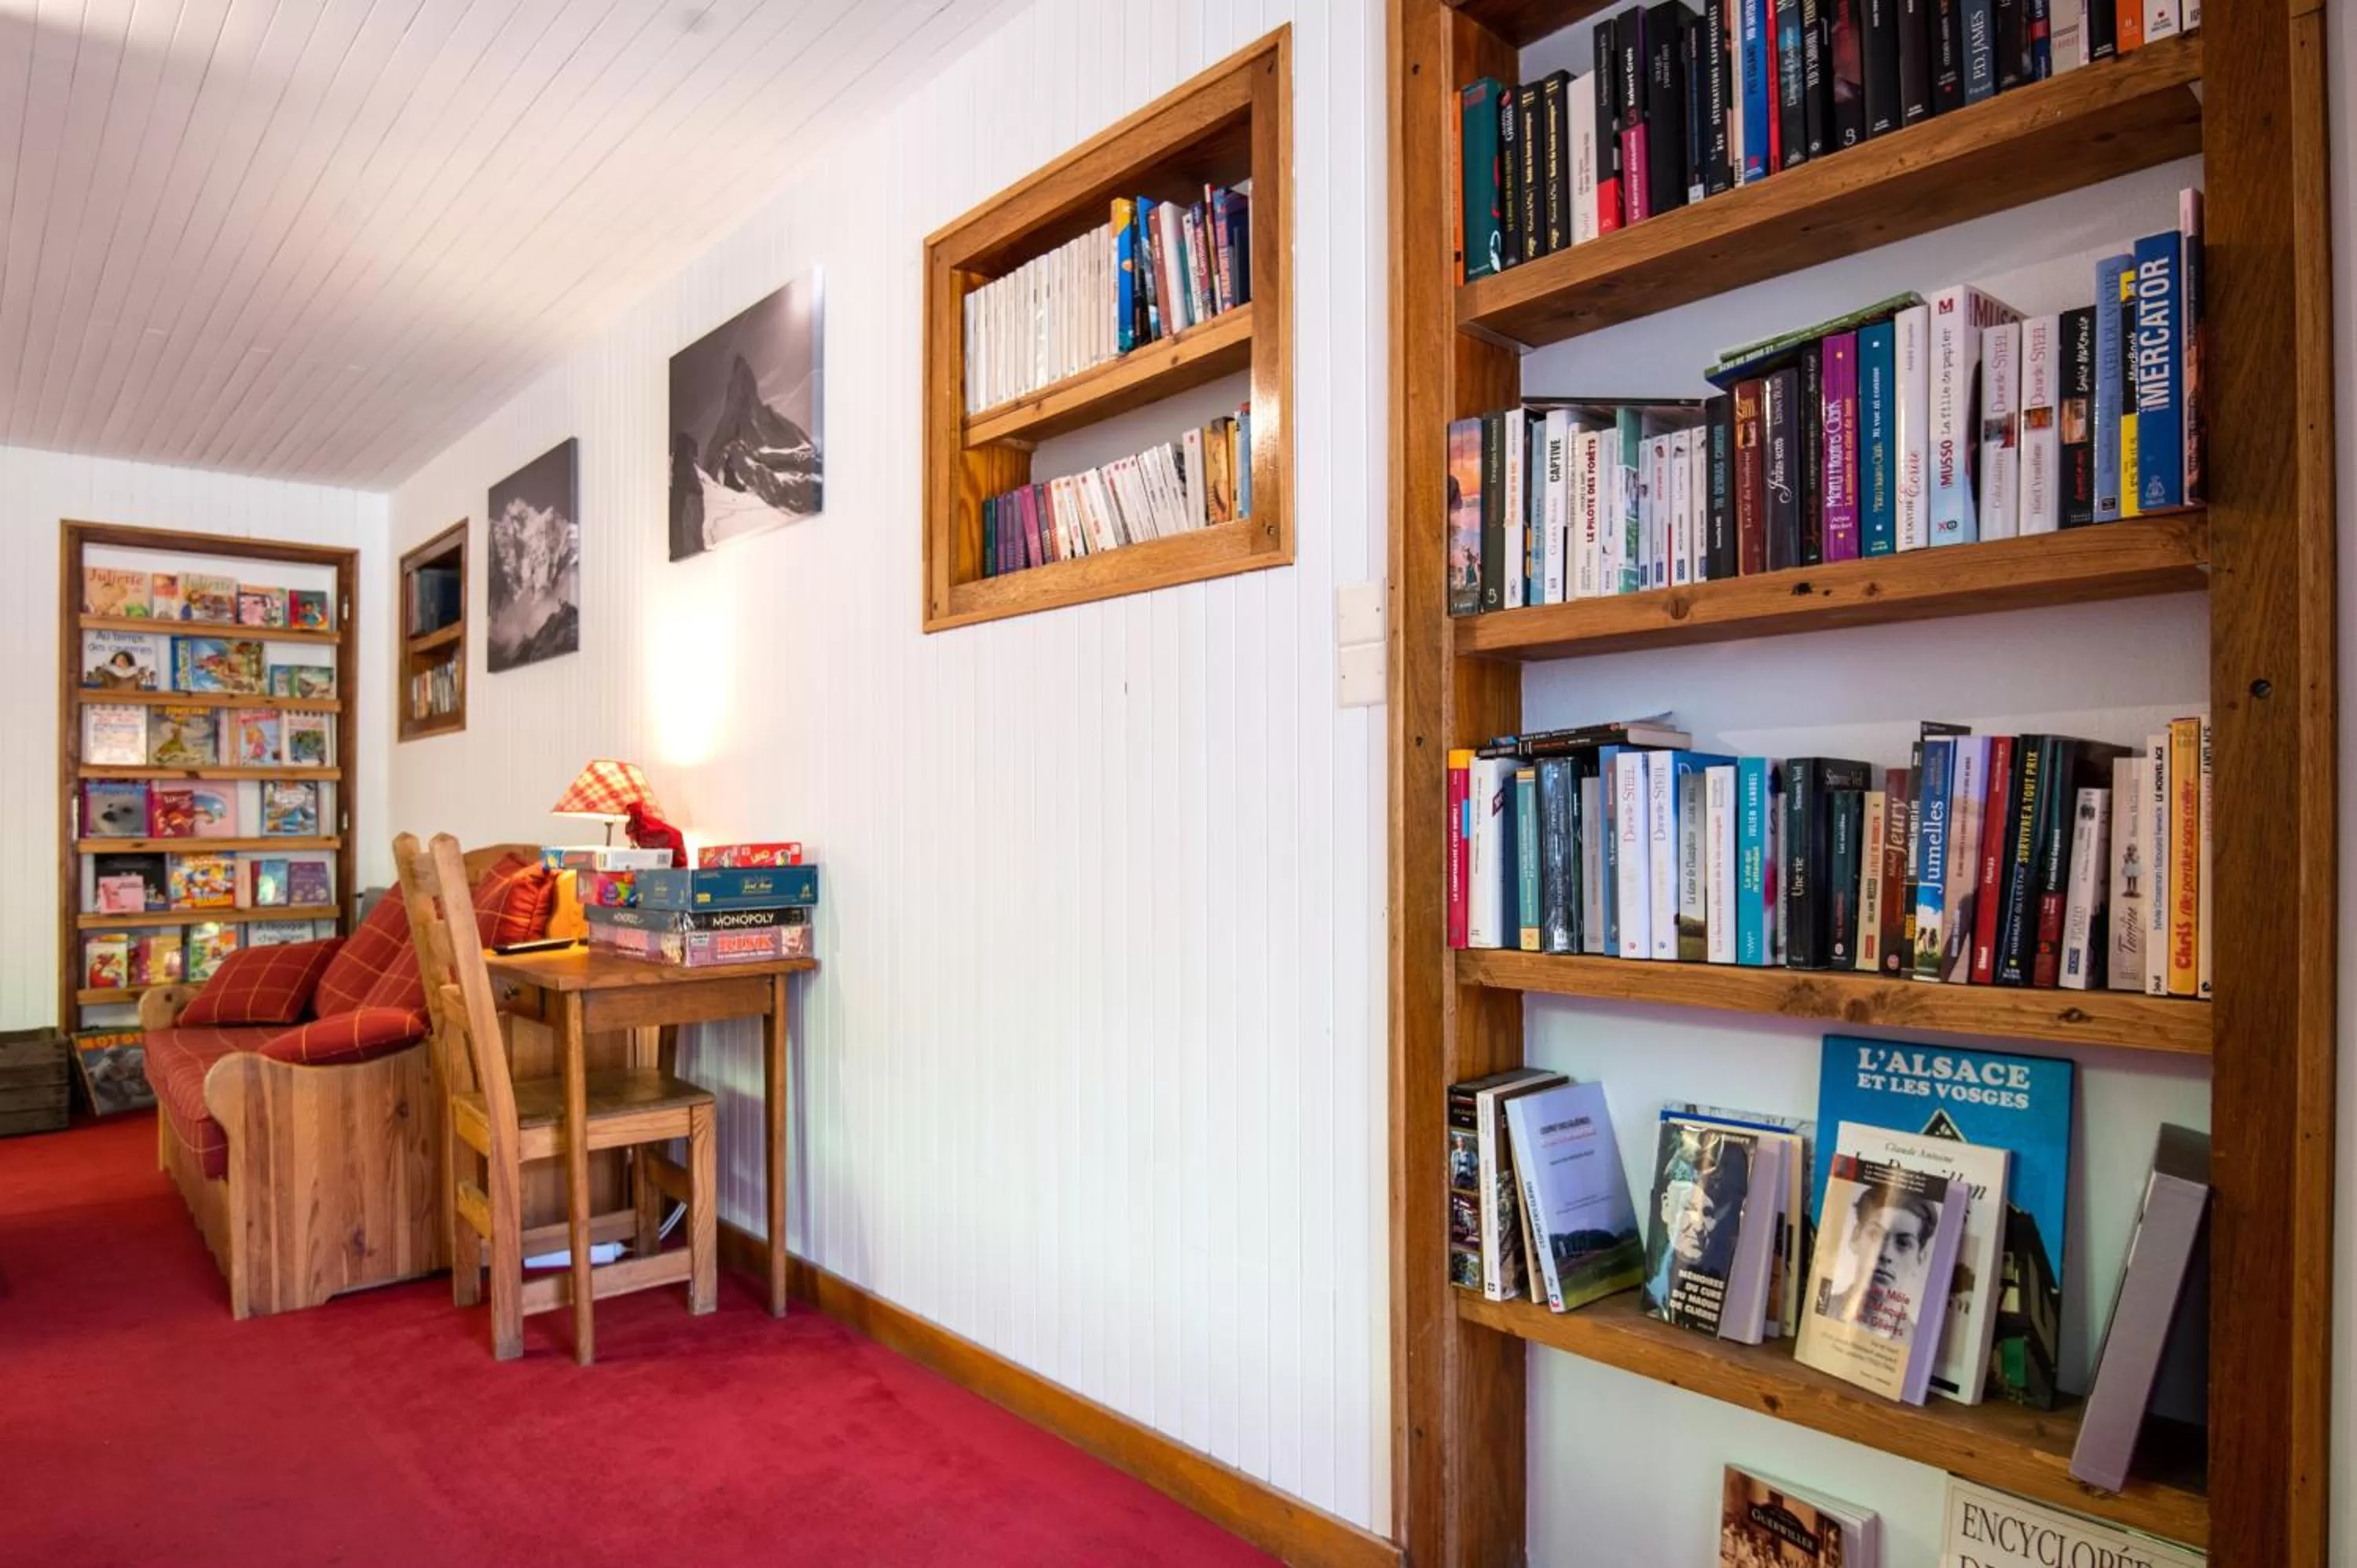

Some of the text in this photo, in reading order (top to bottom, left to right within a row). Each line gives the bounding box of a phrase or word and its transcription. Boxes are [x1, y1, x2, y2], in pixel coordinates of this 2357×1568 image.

[1969, 9, 1985, 57] JAMES
[1626, 47, 1634, 72] Crais
[2139, 255, 2170, 406] MERCATOR
[1825, 398, 1842, 432] Clark
[1844, 419, 1853, 429] de
[1940, 328, 1954, 486] MUSSO La fille de papier
[1490, 454, 1499, 483] Douglas
[1549, 438, 1561, 482] CAPTIVE
[1585, 438, 1596, 542] LE PILOTE DES FORÊTS
[1826, 474, 1845, 507] Mary
[2026, 751, 2038, 776] PRIX
[1622, 765, 1635, 801] STEEL
[1792, 766, 1802, 811] Simone Veil
[2025, 779, 2035, 802] TOUT
[2155, 793, 2163, 802] LE
[1748, 811, 1758, 836] JULIEN
[1885, 797, 1908, 855] Jeury
[2018, 814, 2033, 863] SURVIVRE
[2183, 819, 2194, 845] sans
[1918, 800, 1944, 894] Jumelles
[1744, 877, 1752, 888] La
[1791, 856, 1805, 896] Une vie
[2181, 847, 2195, 892] perdue
[713, 913, 775, 927] MONOPOLY
[2011, 916, 2022, 955] NORMAN
[2175, 921, 2192, 970] Chris
[1858, 1047, 2030, 1090] L'ALSACE
[1857, 1073, 2029, 1109] ET LES VOSGES
[1886, 1142, 1955, 1163] Claude Antoine
[1670, 1299, 1683, 1311] DE
[1672, 1289, 1687, 1300] DU
[1685, 1281, 1699, 1293] DU
[1961, 1501, 2154, 1568] ENCYCLOPÉ
